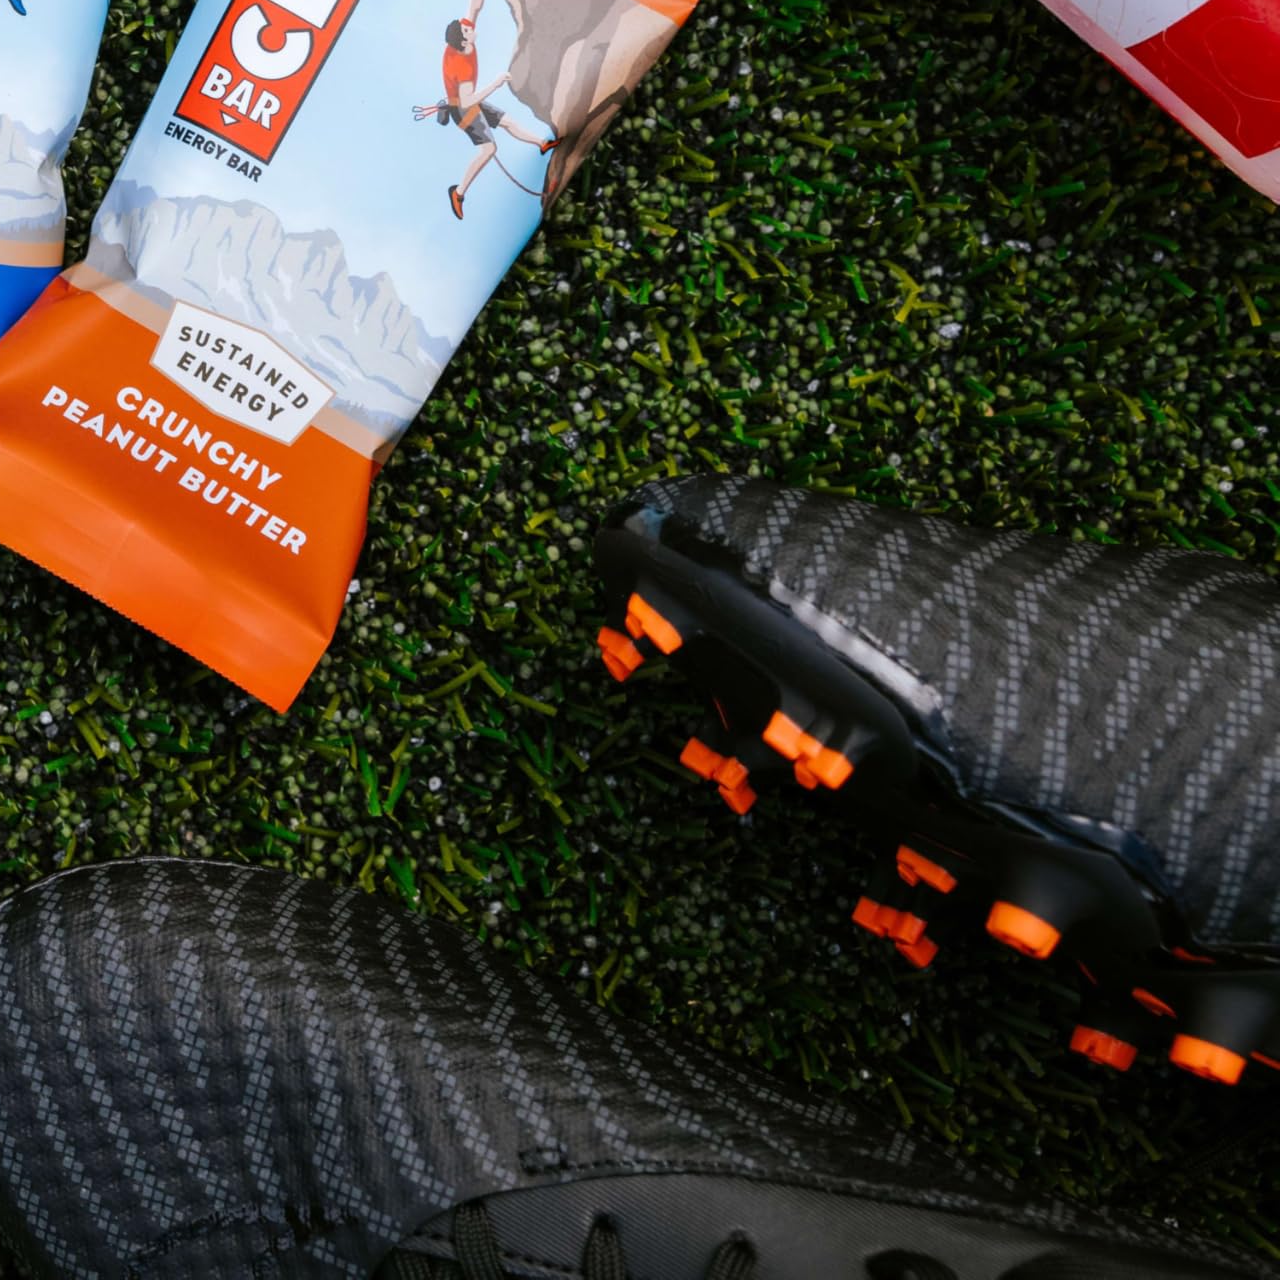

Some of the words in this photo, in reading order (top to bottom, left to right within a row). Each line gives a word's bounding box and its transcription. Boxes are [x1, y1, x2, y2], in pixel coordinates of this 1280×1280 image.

[200, 63, 282, 131] BAR
[164, 121, 228, 160] ENERGY
[226, 154, 263, 183] BAR
[176, 351, 285, 422] ENERGY
[178, 325, 310, 410] SUSTAINED
[41, 385, 178, 473] PEANUT
[178, 466, 308, 556] BUTTER
[116, 386, 283, 492] CRUNCHY
